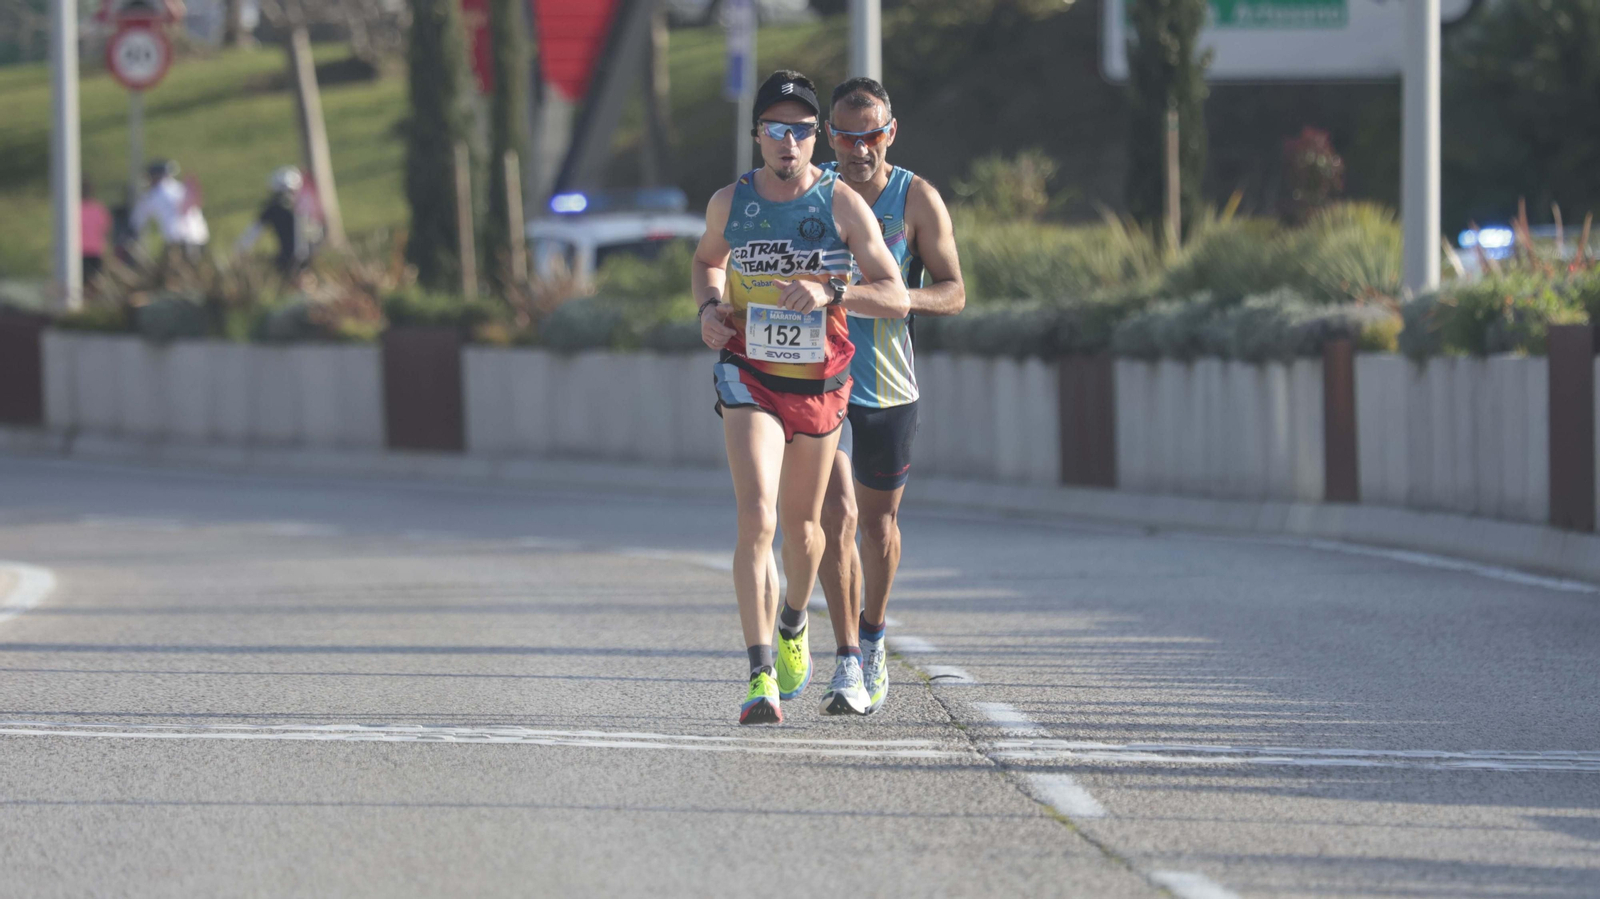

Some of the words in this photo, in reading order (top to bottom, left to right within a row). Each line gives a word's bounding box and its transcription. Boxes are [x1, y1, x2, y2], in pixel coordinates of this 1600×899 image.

[742, 259, 780, 272] TEAM
[769, 312, 801, 320] MARATÓN
[764, 324, 801, 346] 152
[765, 350, 801, 359] EVOS
